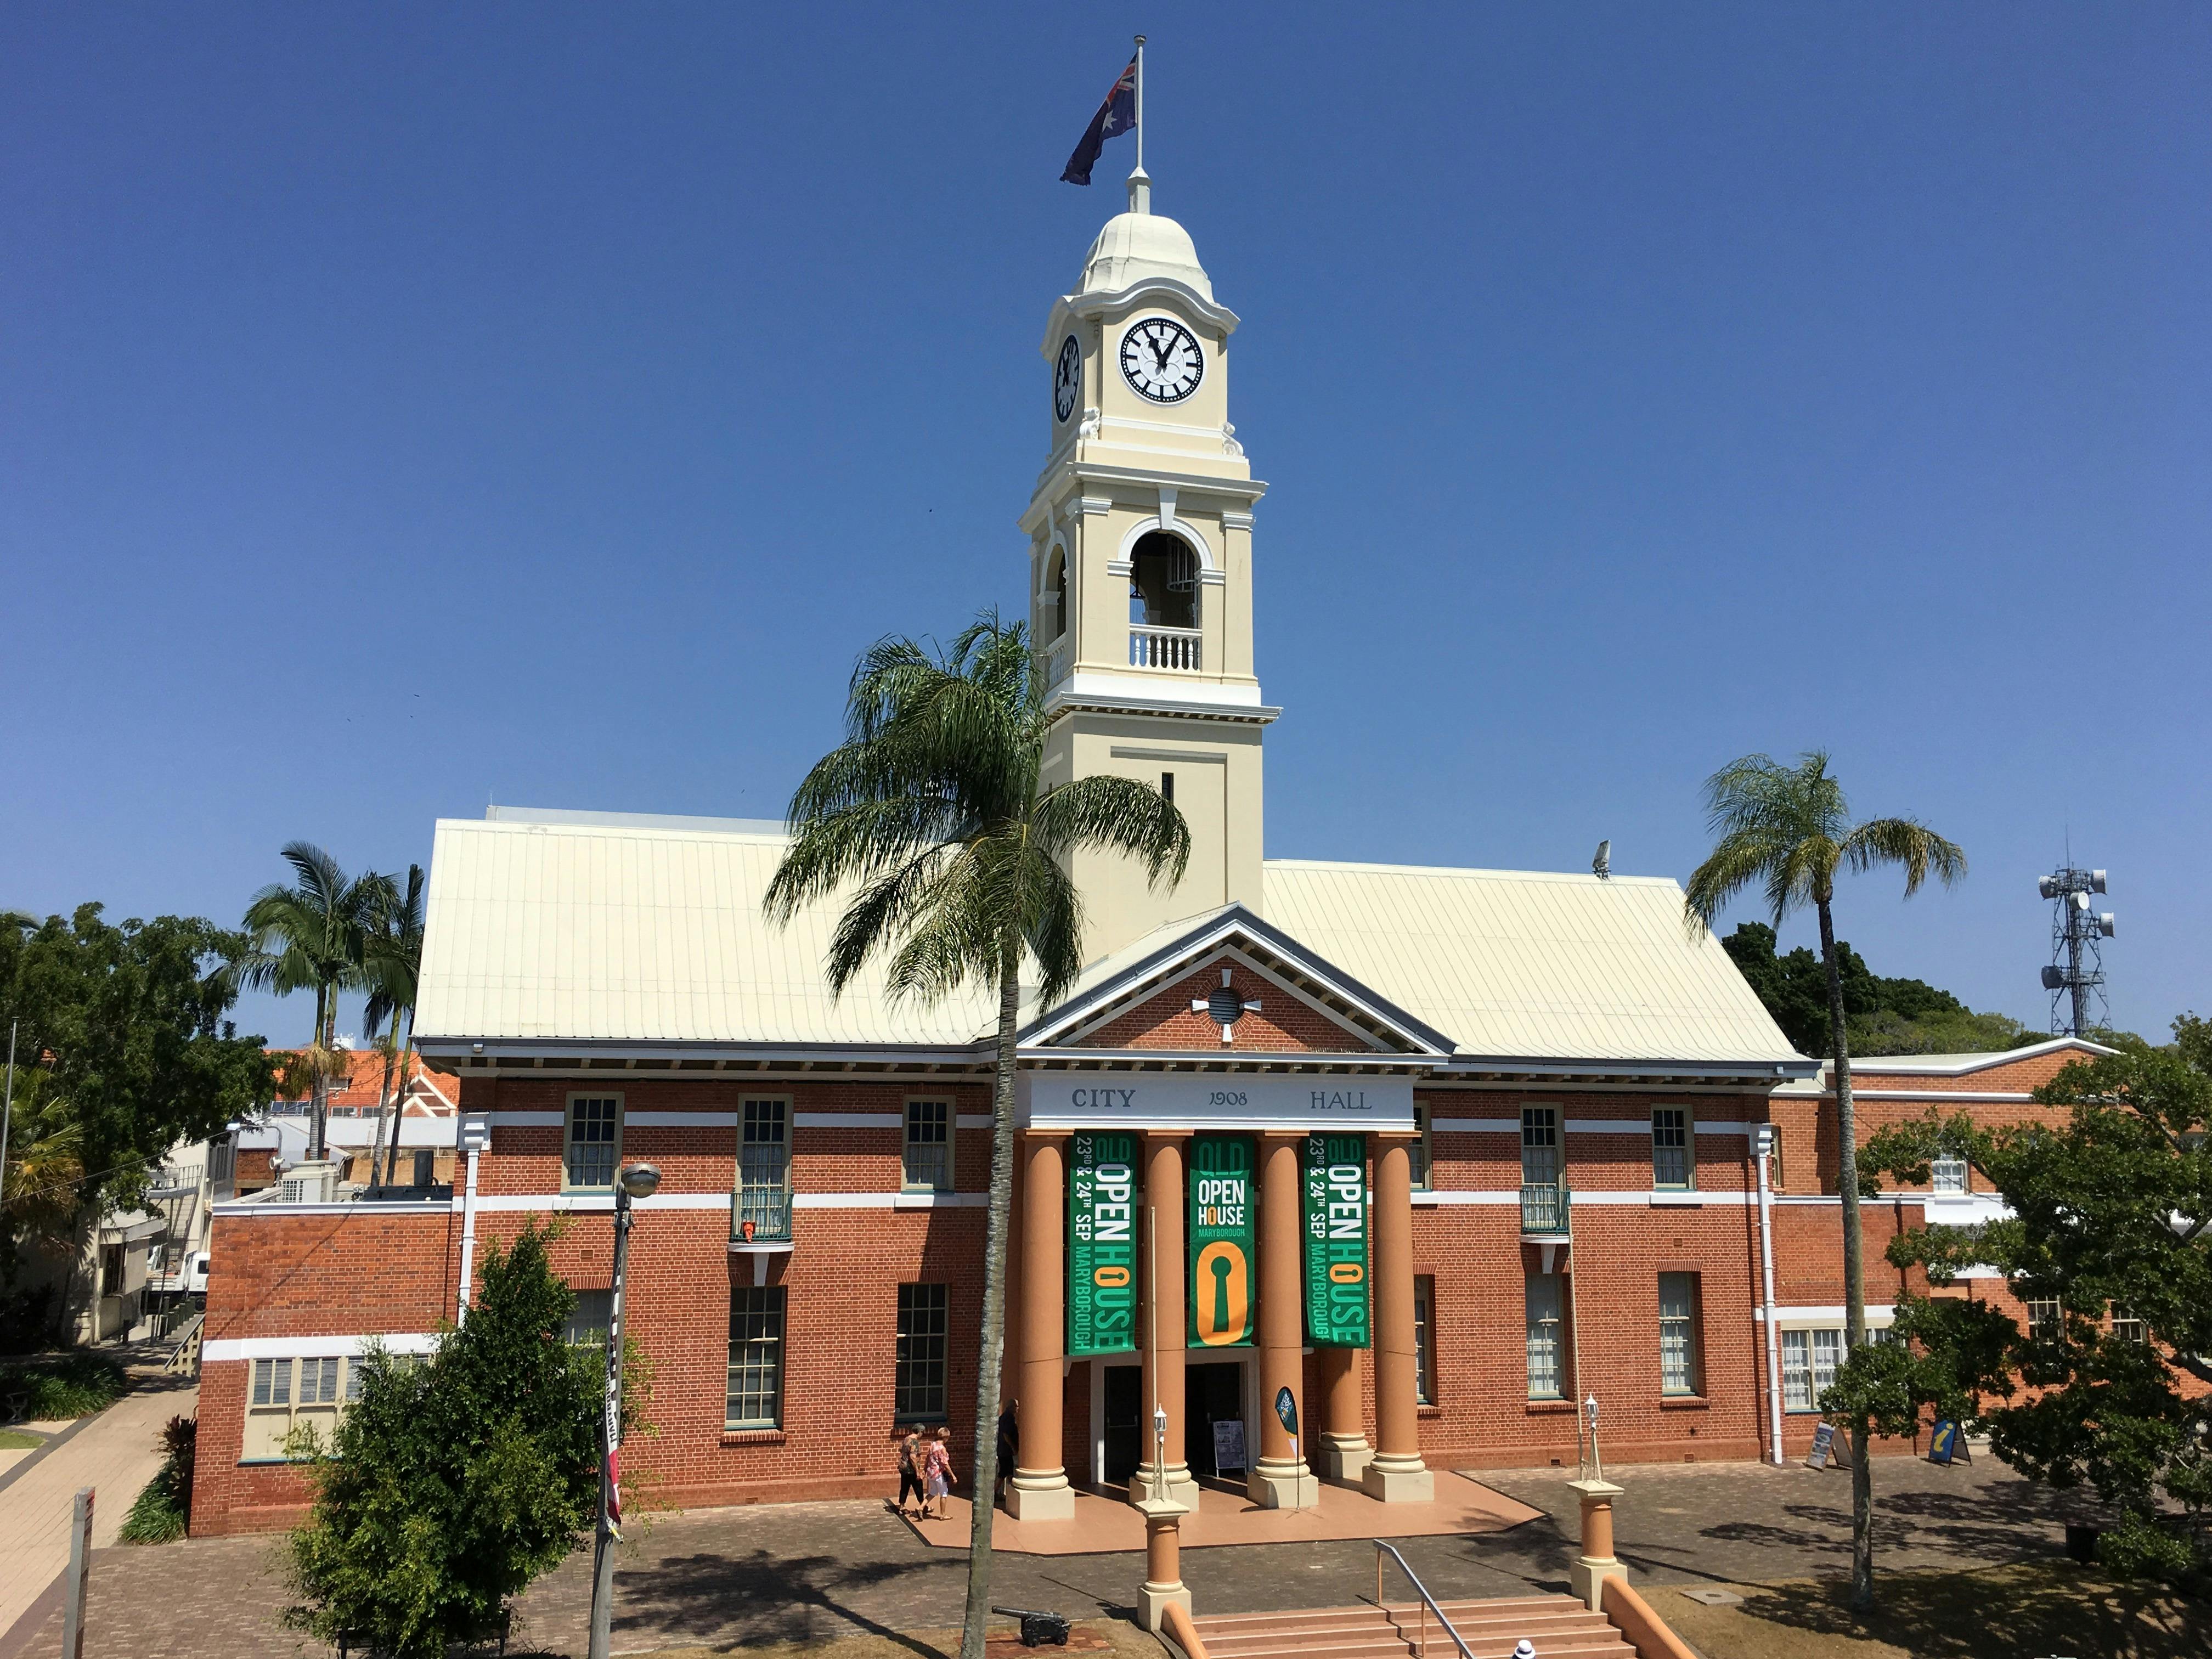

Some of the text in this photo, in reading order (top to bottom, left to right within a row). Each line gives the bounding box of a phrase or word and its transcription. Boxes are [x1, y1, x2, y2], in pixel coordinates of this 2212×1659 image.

[1071, 1088, 1372, 1109] CITY 1908 HALL
[1199, 1142, 1244, 1177] QLD
[1310, 1138, 1324, 1165] 23RD
[1310, 1167, 1325, 1177] &
[1198, 1180, 1245, 1204] OPEN
[1310, 1181, 1325, 1207] 24TH
[1198, 1206, 1245, 1225] HOUSE
[1311, 1212, 1325, 1239] SEP
[1075, 1137, 1092, 1350] 23RD & 24TH SEP MARYBOROUGH
[1094, 1137, 1131, 1348] QLD OPEN HOUSE
[1198, 1228, 1245, 1237] MARYBOROUGH
[1328, 1139, 1364, 1342] QLD OPEN HOUSE
